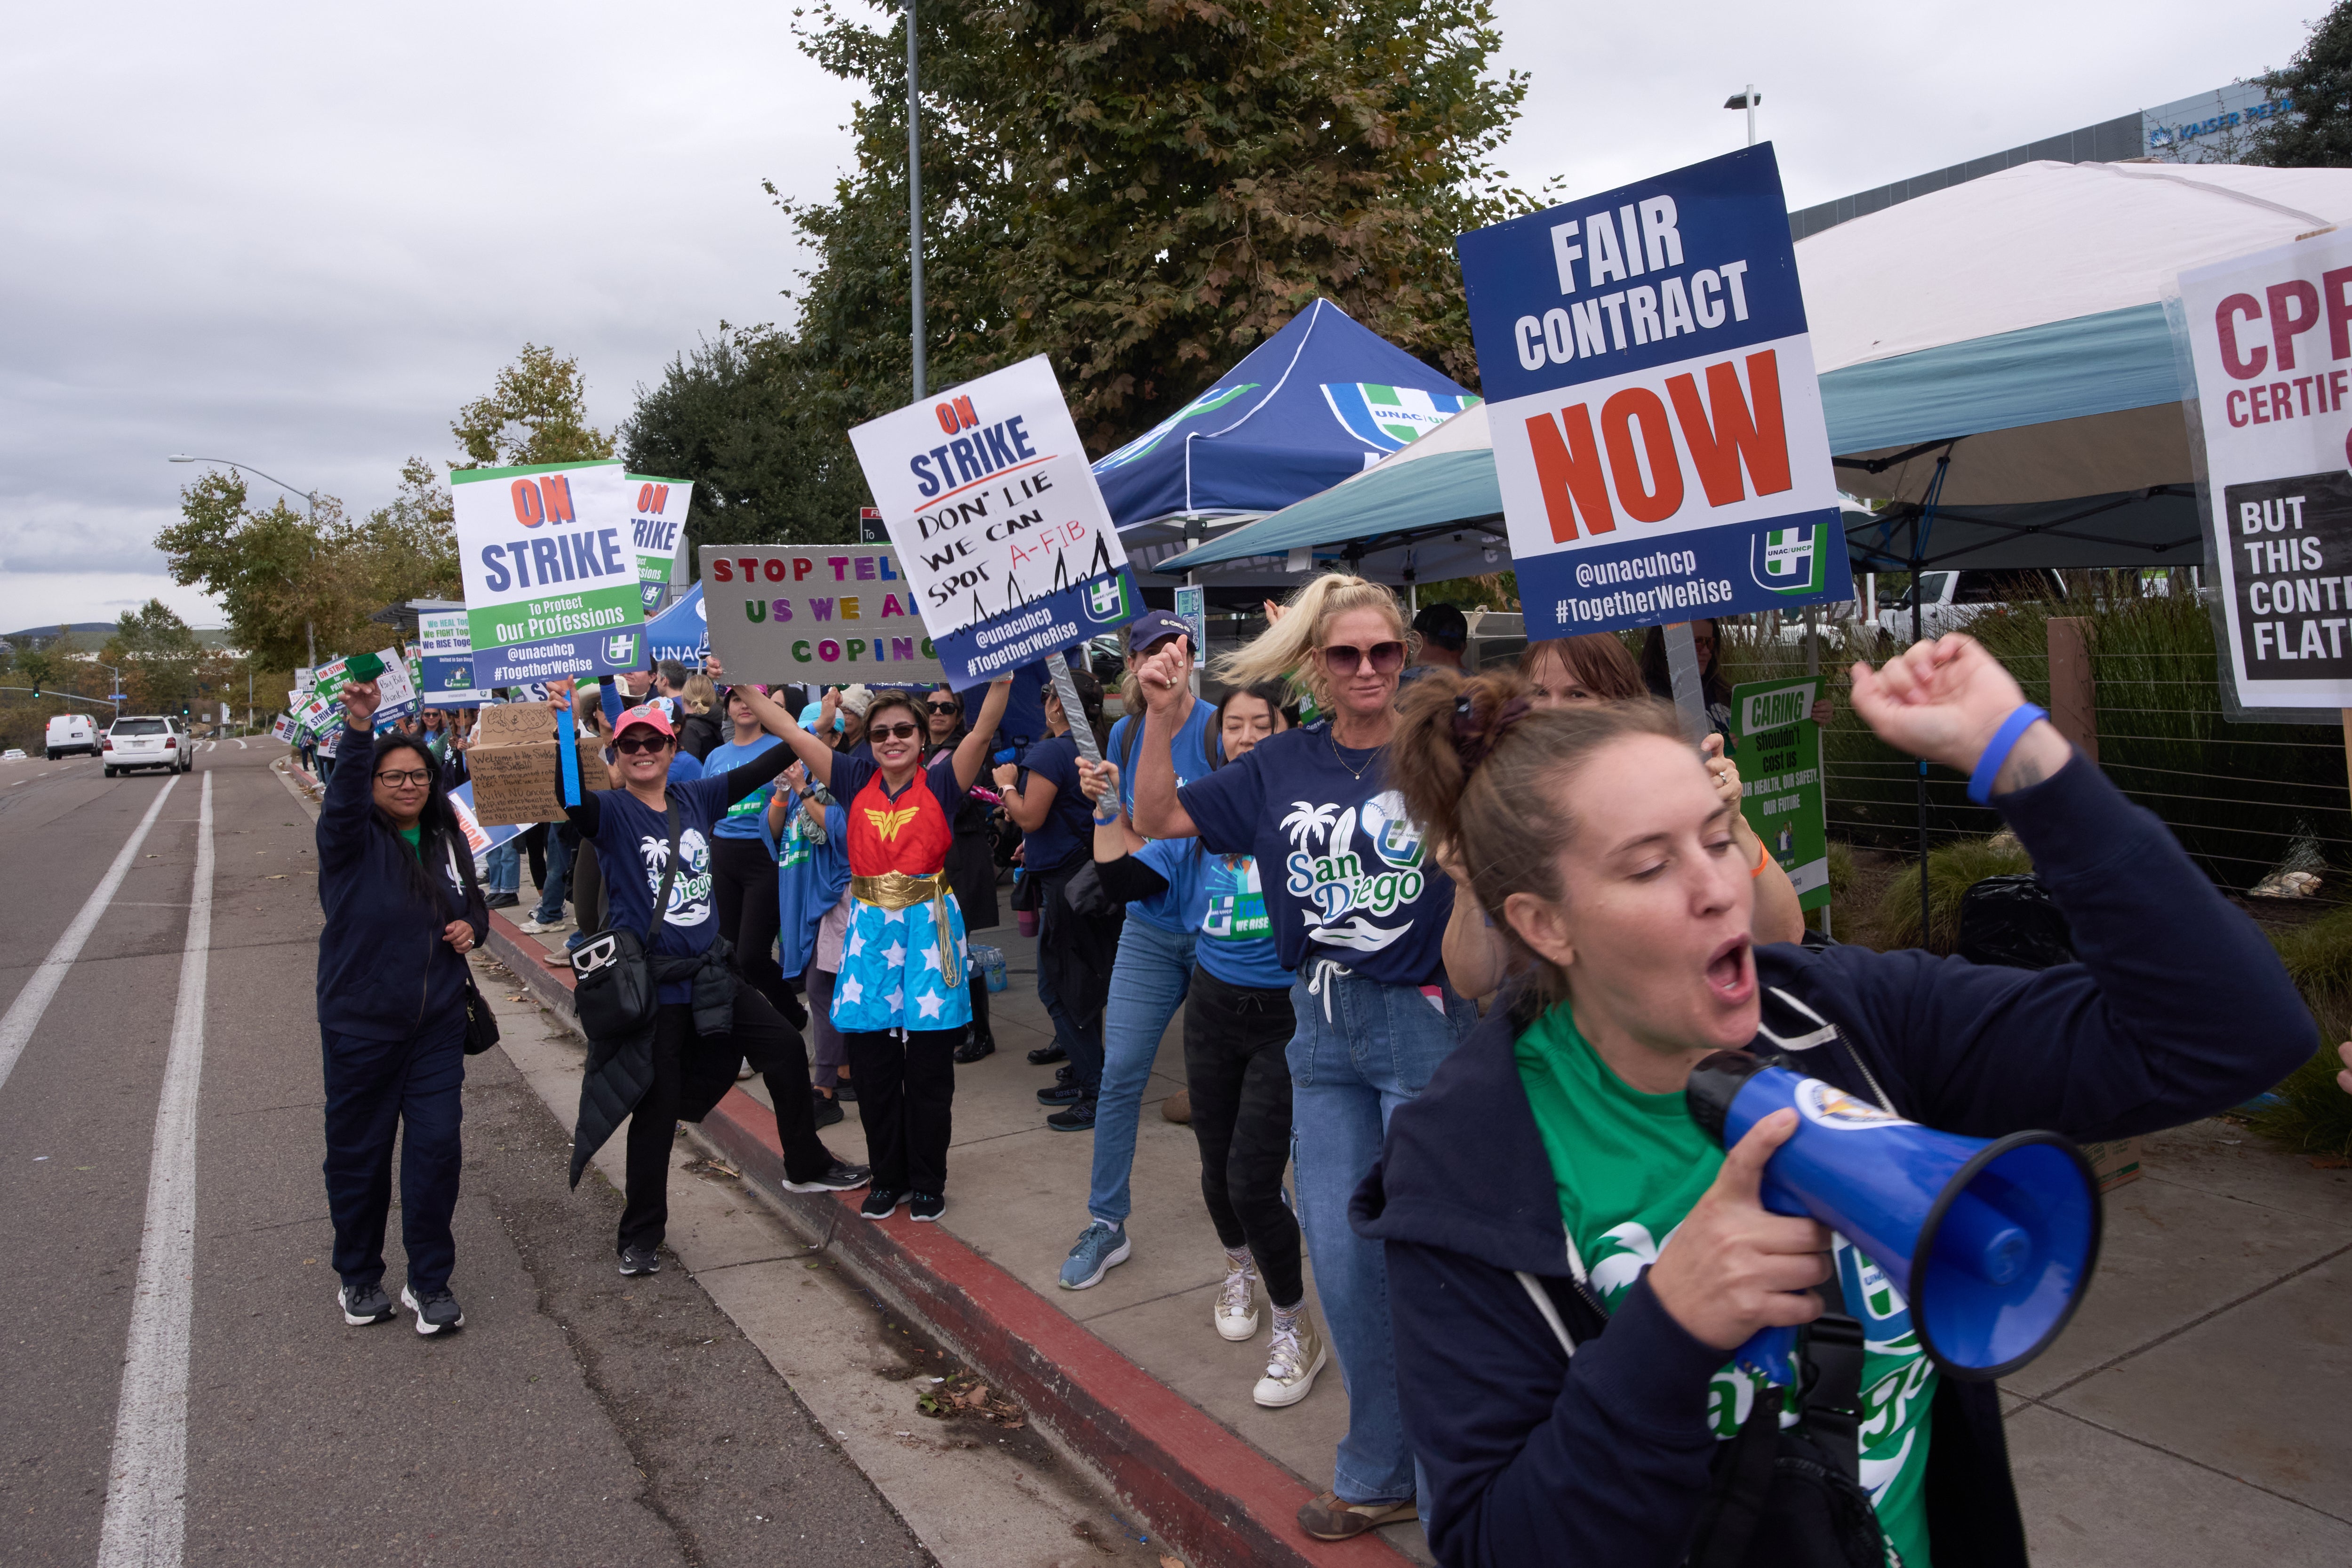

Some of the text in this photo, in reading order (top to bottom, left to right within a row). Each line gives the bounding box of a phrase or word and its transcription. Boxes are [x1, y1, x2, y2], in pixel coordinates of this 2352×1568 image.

[2179, 112, 2240, 141] KAISER
[1550, 194, 1685, 296] FAIR
[1515, 260, 1748, 371] CONTRACT
[2226, 368, 2352, 429] CERTIF
[935, 394, 980, 435] ON
[1375, 410, 1445, 424] UNAC/U
[910, 415, 1036, 497] STRIKE
[1525, 349, 1792, 544] NOW
[511, 474, 576, 528] ON
[637, 483, 669, 514] ON
[1003, 471, 1053, 507] LIE
[2240, 496, 2306, 536] BUT
[864, 529, 874, 539] To
[920, 510, 1043, 572] WE CAN
[481, 528, 625, 592] STRIKE
[928, 560, 990, 608] SPOT
[1010, 520, 1085, 570] A-FIB
[1768, 545, 1812, 556] UNAC/UHCP
[2244, 536, 2323, 575] THIS
[713, 556, 906, 582] STOP TEL
[1576, 549, 1697, 588] @unacuhcp
[528, 596, 583, 616] To Protect
[745, 598, 793, 623] US
[809, 596, 861, 621] WE
[1556, 577, 1732, 624] #TogetherWeRise
[423, 628, 470, 638] We FIGHT Tog
[427, 620, 438, 628] We
[440, 619, 455, 627] HEAL
[496, 607, 625, 643] Our Professions
[976, 608, 1052, 648] @unacuhcp
[422, 640, 434, 649] We
[436, 639, 451, 648] RISE
[508, 643, 574, 662] @unacuhcp
[967, 621, 1078, 678] #TogetherWeRise
[319, 670, 328, 679] ON
[380, 674, 405, 690] Pay Bills
[494, 658, 592, 681] #TogetherWeRise
[531, 683, 547, 701] S
[310, 702, 323, 713] ON
[311, 707, 334, 726] STRIK
[1752, 691, 1804, 728] CARING
[275, 721, 285, 730] ON
[283, 720, 297, 740] STRIKE
[1756, 726, 1800, 752] shouldn't
[473, 752, 512, 764] Welcome
[514, 752, 520, 760] to
[521, 751, 532, 761] the
[1763, 751, 1797, 773] cost us
[478, 790, 505, 800] With
[1754, 776, 1782, 796] HEALTH,
[1783, 773, 1795, 789] OUR
[1795, 768, 1819, 786] SAFETY,
[1763, 793, 1800, 816] OUR FUTURE
[1290, 853, 1360, 893] San
[1239, 899, 1267, 917] TOG
[1315, 872, 1421, 919] Diego
[1236, 917, 1269, 932] WE RISE
